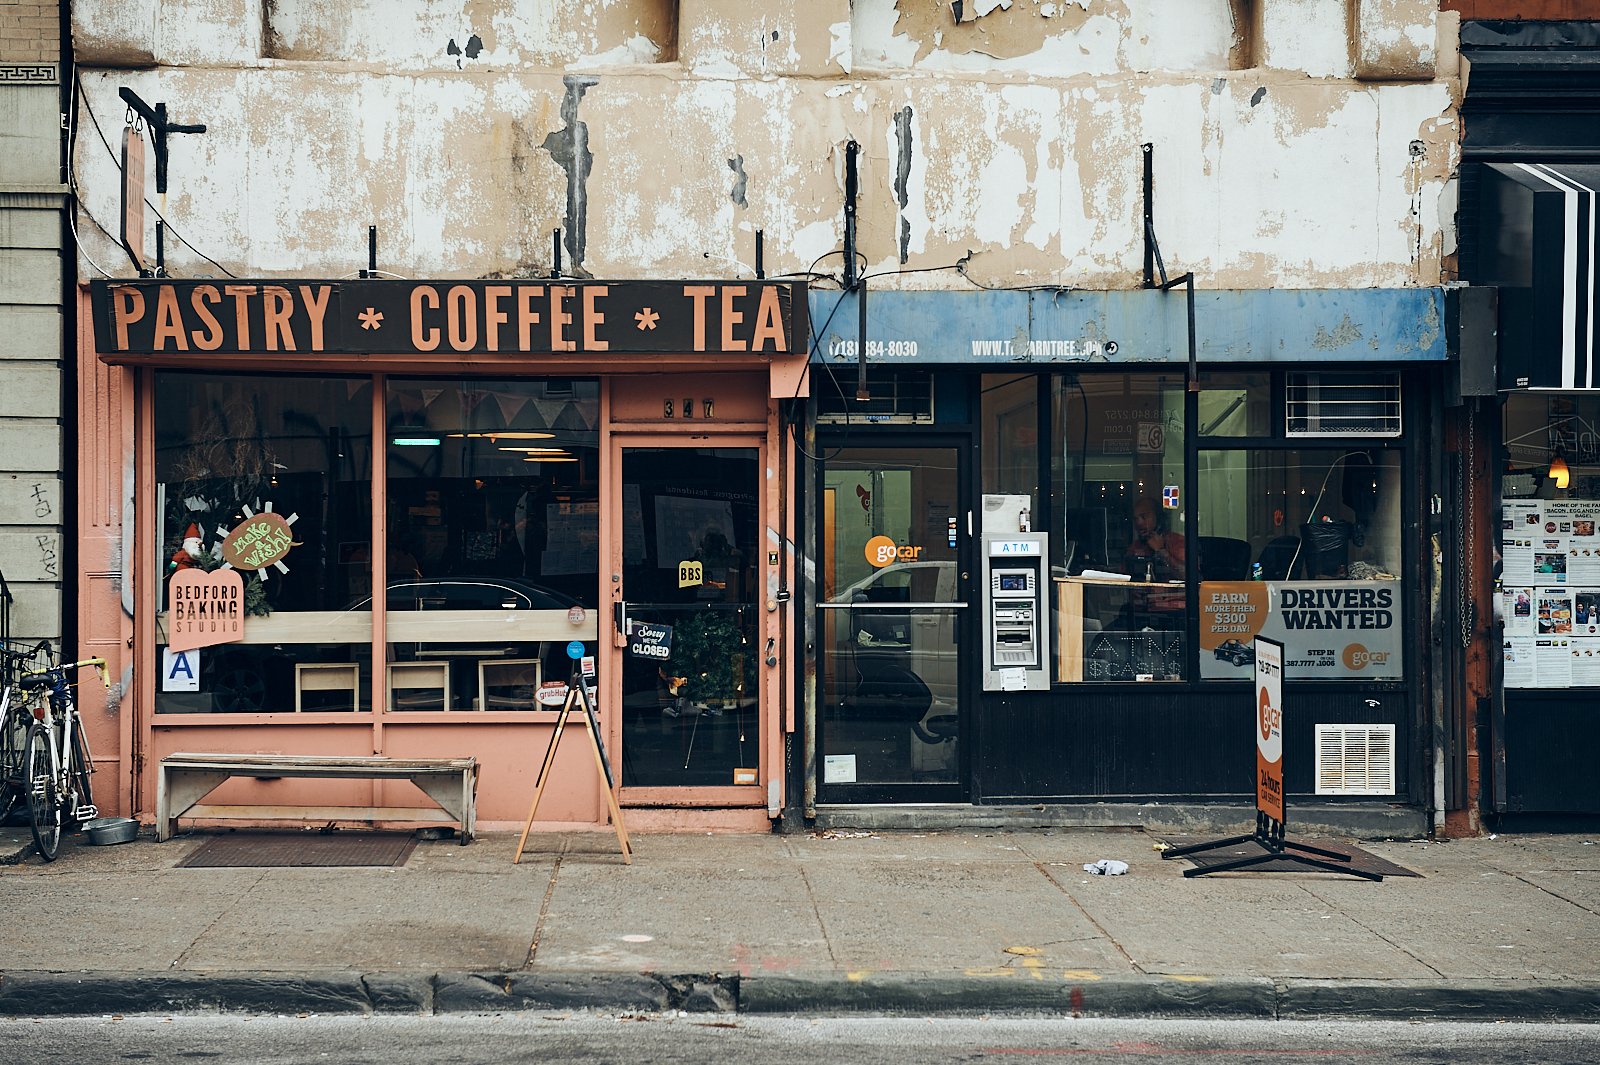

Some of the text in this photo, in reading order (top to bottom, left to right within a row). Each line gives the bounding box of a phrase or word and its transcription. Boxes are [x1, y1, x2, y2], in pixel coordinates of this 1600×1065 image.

[112, 284, 788, 352] PASTRY COFFEE TEA
[876, 545, 922, 563] gocar
[1002, 543, 1030, 552] ATM
[680, 567, 701, 581] BBS
[176, 585, 238, 600] BEDFORD
[1211, 593, 1249, 604] EARN
[1280, 588, 1393, 609] DRIVERS
[176, 600, 238, 620] BAKING
[1204, 605, 1256, 613] MORE THEN
[1214, 612, 1247, 625] $300
[1281, 610, 1393, 630] WANTED
[176, 621, 238, 633] STUDIO
[637, 625, 666, 643] Sorry
[1210, 625, 1250, 633] PER DAY!
[632, 643, 669, 657] CLOSED
[1091, 636, 1180, 658] ATM
[168, 653, 194, 679] A
[1352, 651, 1391, 666] gocar
